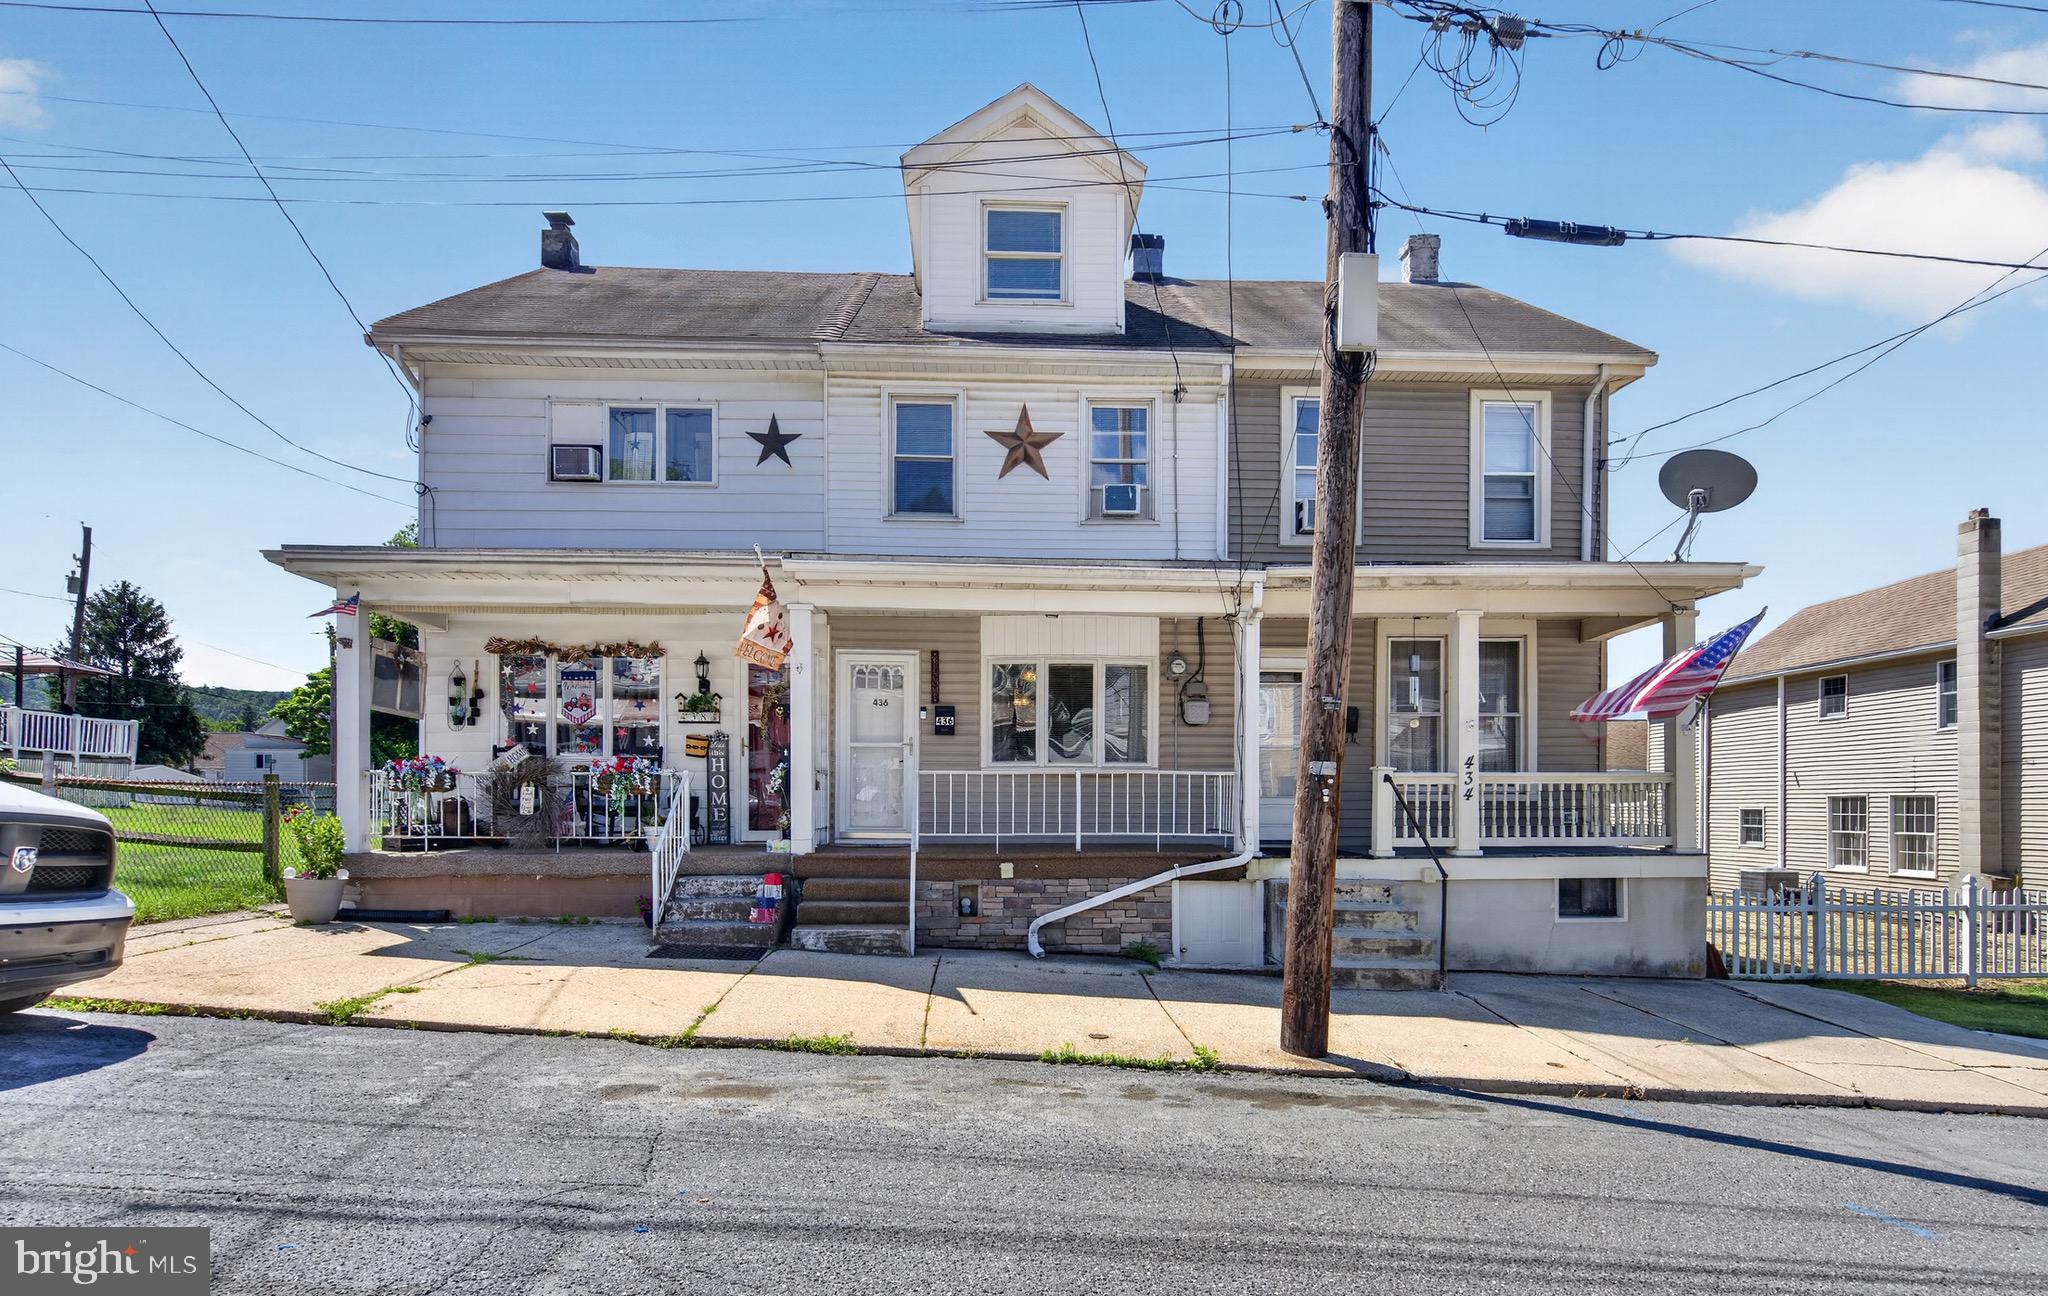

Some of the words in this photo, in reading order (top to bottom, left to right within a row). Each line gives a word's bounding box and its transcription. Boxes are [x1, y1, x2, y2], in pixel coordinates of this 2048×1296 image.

[872, 698, 889, 707] 436
[936, 716, 954, 726] 436
[711, 758, 727, 821] HOME
[1463, 755, 1474, 801] 434
